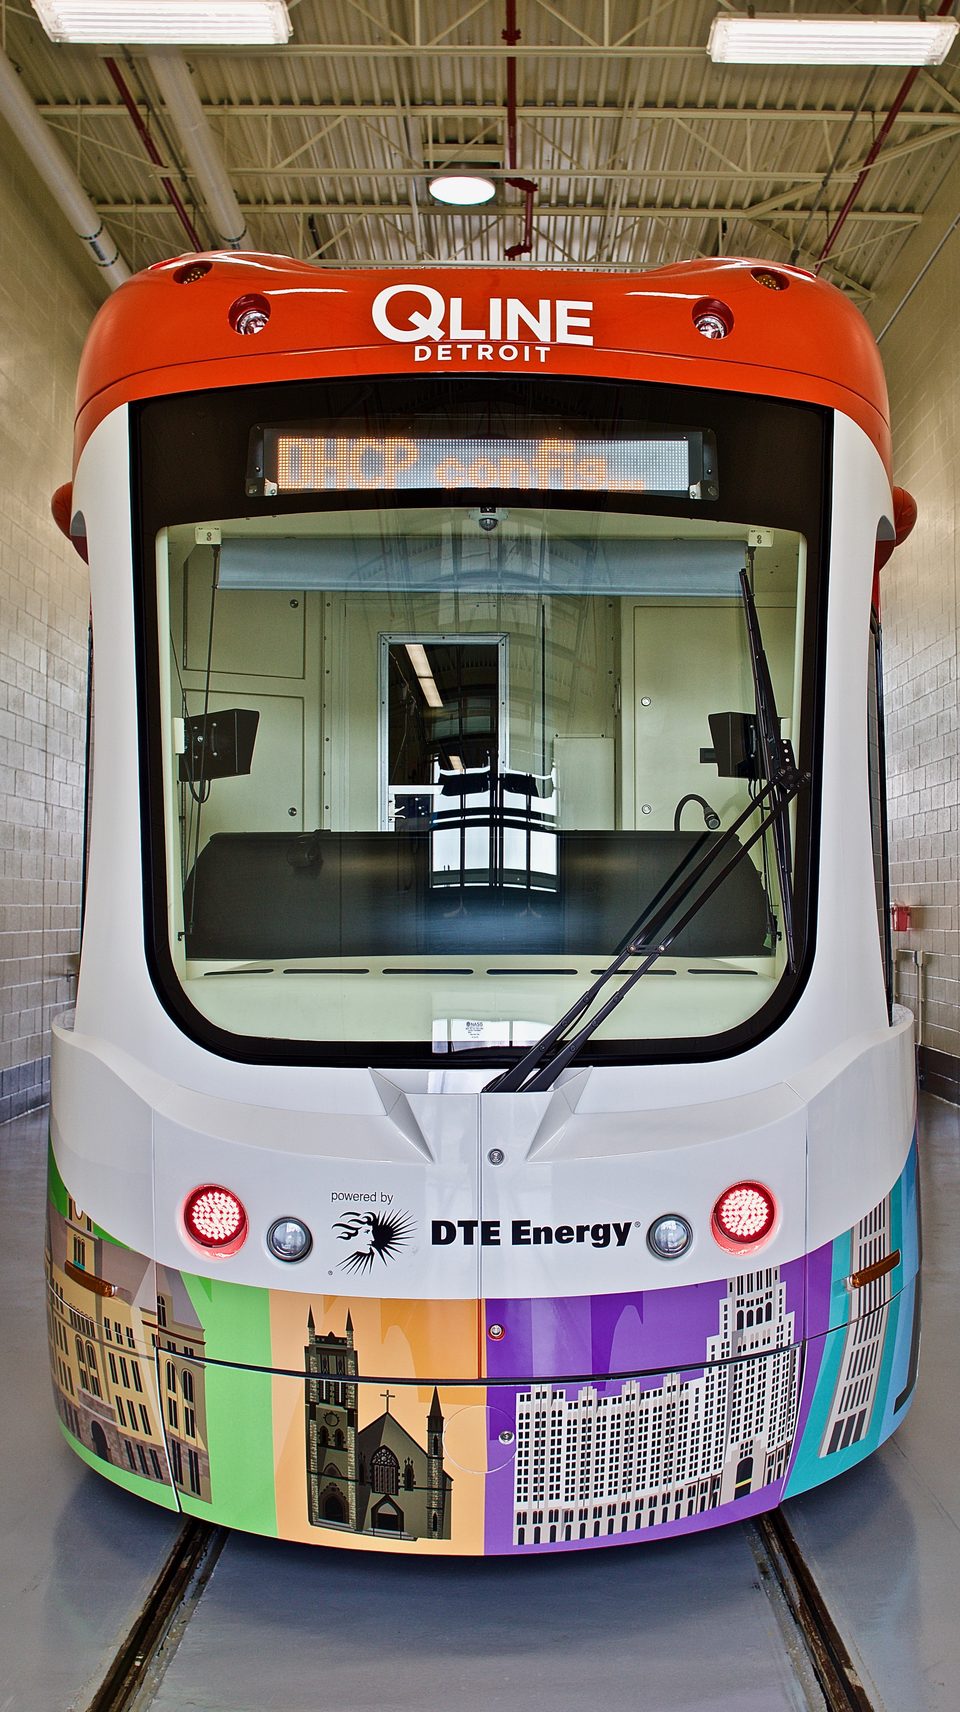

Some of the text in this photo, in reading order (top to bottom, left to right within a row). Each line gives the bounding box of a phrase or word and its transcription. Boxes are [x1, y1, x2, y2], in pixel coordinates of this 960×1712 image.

[371, 284, 594, 346] QLINE
[414, 344, 551, 363] DETROIT
[277, 437, 418, 490] DHCP
[331, 1192, 394, 1206] powered by
[431, 1220, 633, 1249] DTE Energy
